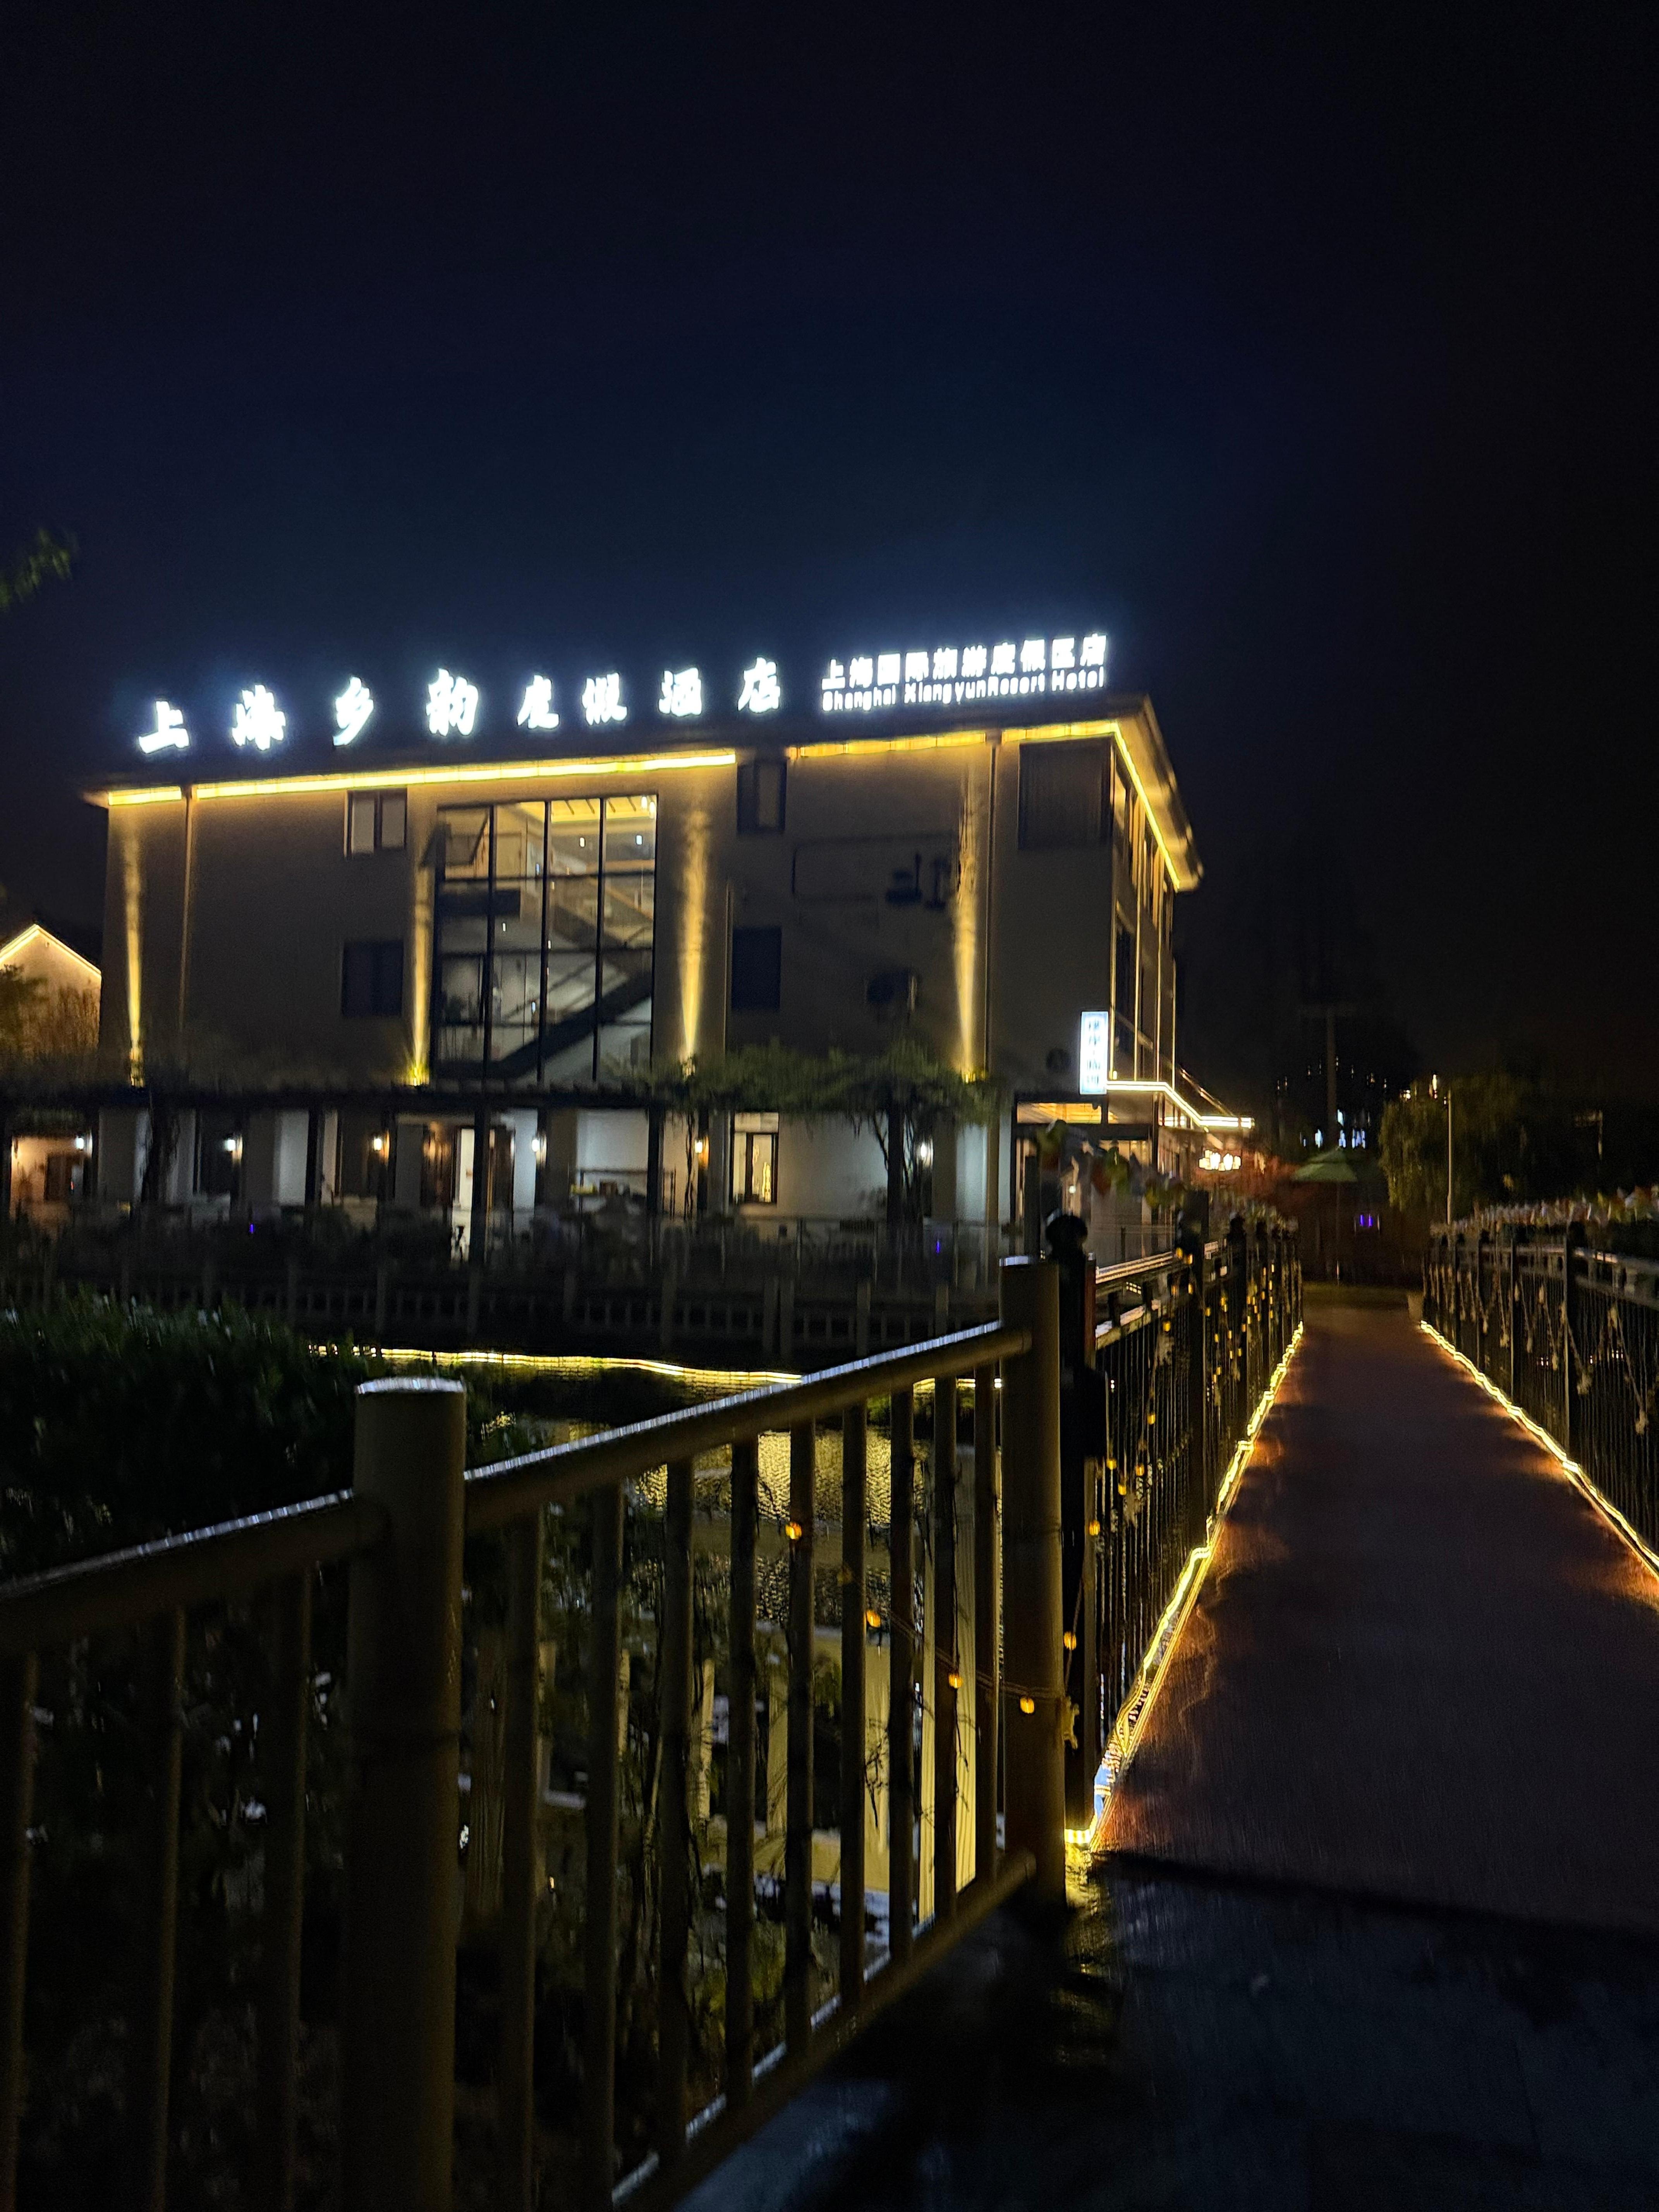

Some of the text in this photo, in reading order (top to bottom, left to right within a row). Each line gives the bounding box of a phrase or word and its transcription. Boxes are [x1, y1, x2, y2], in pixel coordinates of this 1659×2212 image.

[139, 658, 780, 753] 上海乡韵度假酒店
[822, 685, 897, 712] Shanghai
[1050, 666, 1105, 691] Hotel
